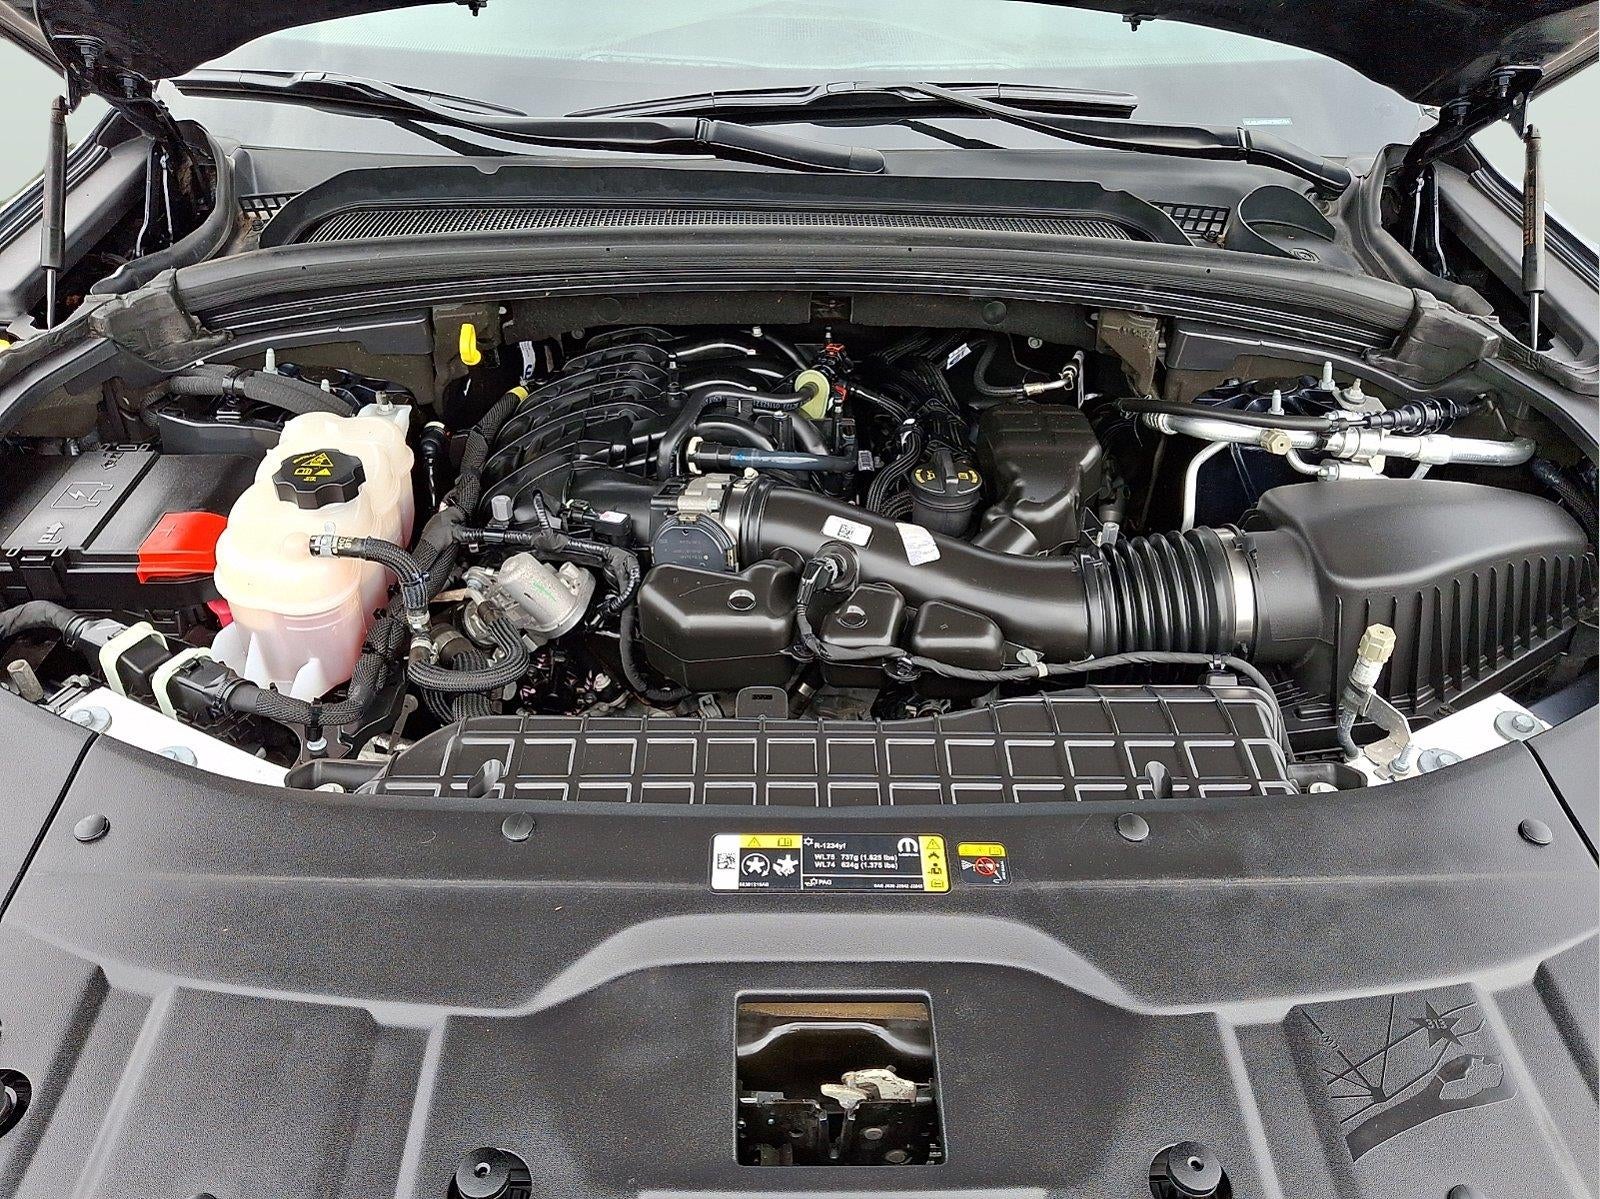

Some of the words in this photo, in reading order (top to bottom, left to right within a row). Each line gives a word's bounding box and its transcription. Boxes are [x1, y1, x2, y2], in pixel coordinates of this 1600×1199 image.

[814, 842, 847, 851] R-1234yf
[814, 853, 835, 861] WL75
[841, 854, 859, 862] 737g
[883, 854, 898, 862] lbs)
[814, 861, 836, 869] WL74
[841, 861, 859, 870] 624g
[860, 861, 882, 870] (1.375
[883, 862, 898, 871] lbs)
[1425, 1018, 1448, 1030] 313
